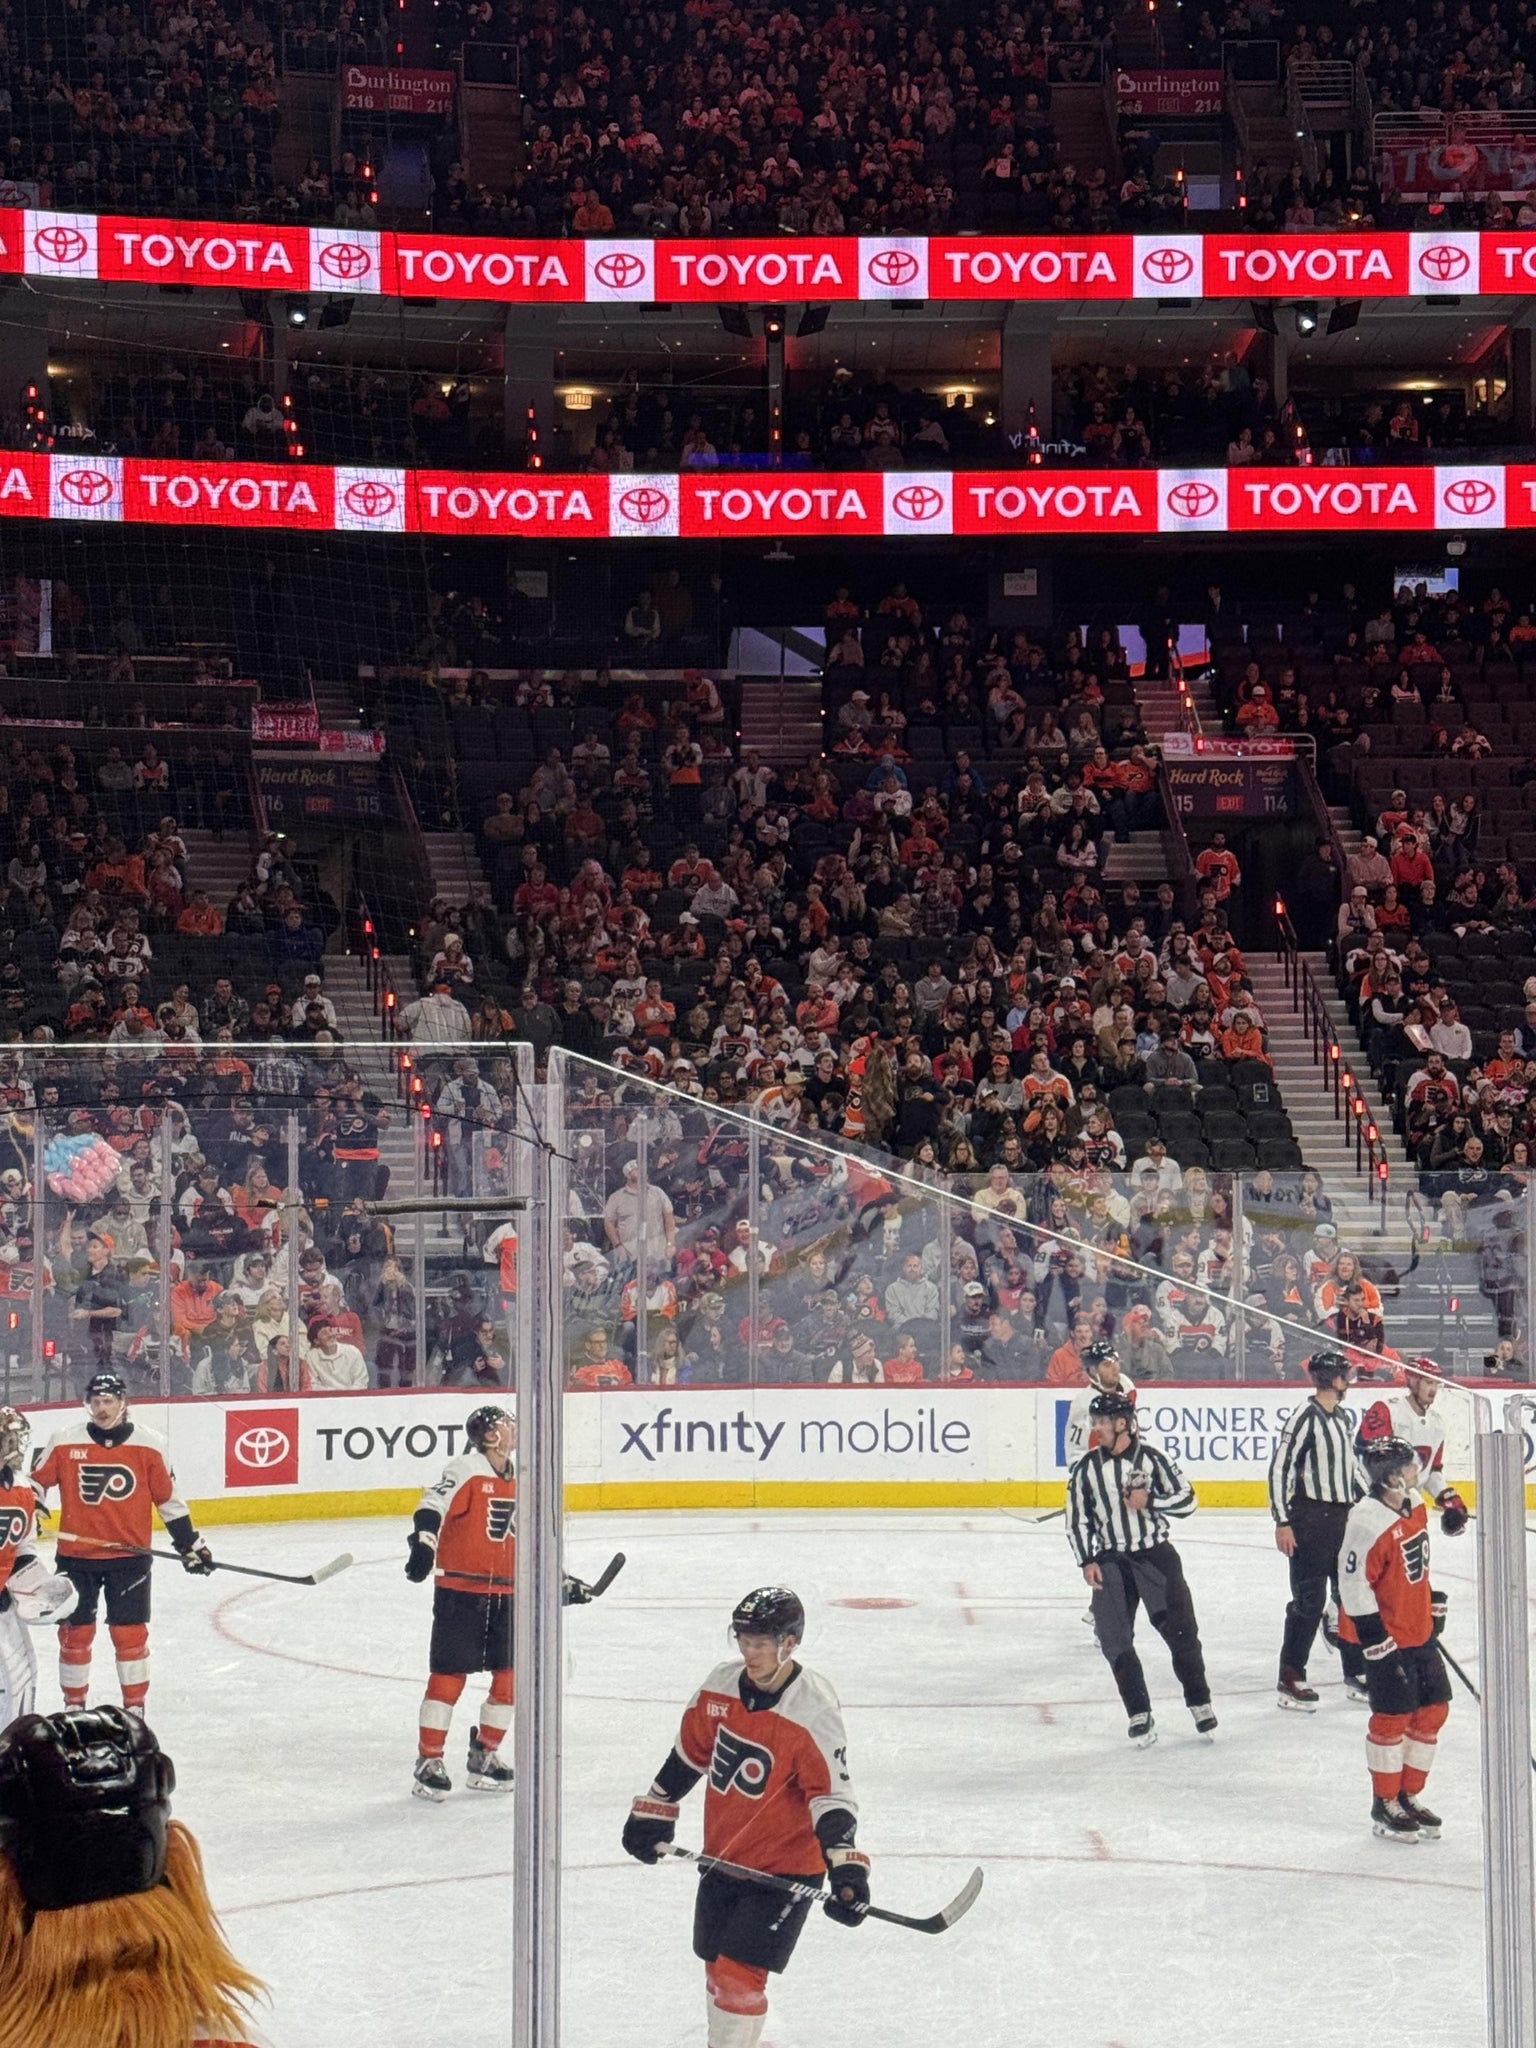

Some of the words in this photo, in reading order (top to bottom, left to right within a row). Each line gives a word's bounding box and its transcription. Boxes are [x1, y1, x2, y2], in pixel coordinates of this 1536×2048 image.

[348, 68, 450, 96] Burlington
[1117, 73, 1220, 97] Burlington
[347, 95, 374, 109] 216
[1195, 99, 1221, 113] 214
[115, 233, 294, 274] TOYOTA
[398, 249, 570, 287] TOYOTA
[945, 252, 1118, 285] TOYOTA
[1220, 248, 1394, 282] TOYOTA
[672, 255, 843, 287] TOYOTA
[140, 475, 319, 514] TOYOTA
[423, 486, 594, 522] TOYOTA
[696, 489, 868, 521] TOYOTA
[970, 486, 1143, 519] TOYOTA
[1245, 482, 1419, 515] TOYOTA
[260, 767, 300, 784] Hard
[300, 768, 336, 786] Rock
[1169, 768, 1206, 784] Hard
[1208, 768, 1244, 787] Rock
[1221, 796, 1240, 810] EXIT
[1263, 794, 1288, 813] 114
[619, 1407, 786, 1461] xfinity
[800, 1407, 971, 1453] mobile
[1137, 1406, 1269, 1433] CONNER
[316, 1424, 473, 1461] TOYOT
[706, 1702, 730, 1718] IBX
